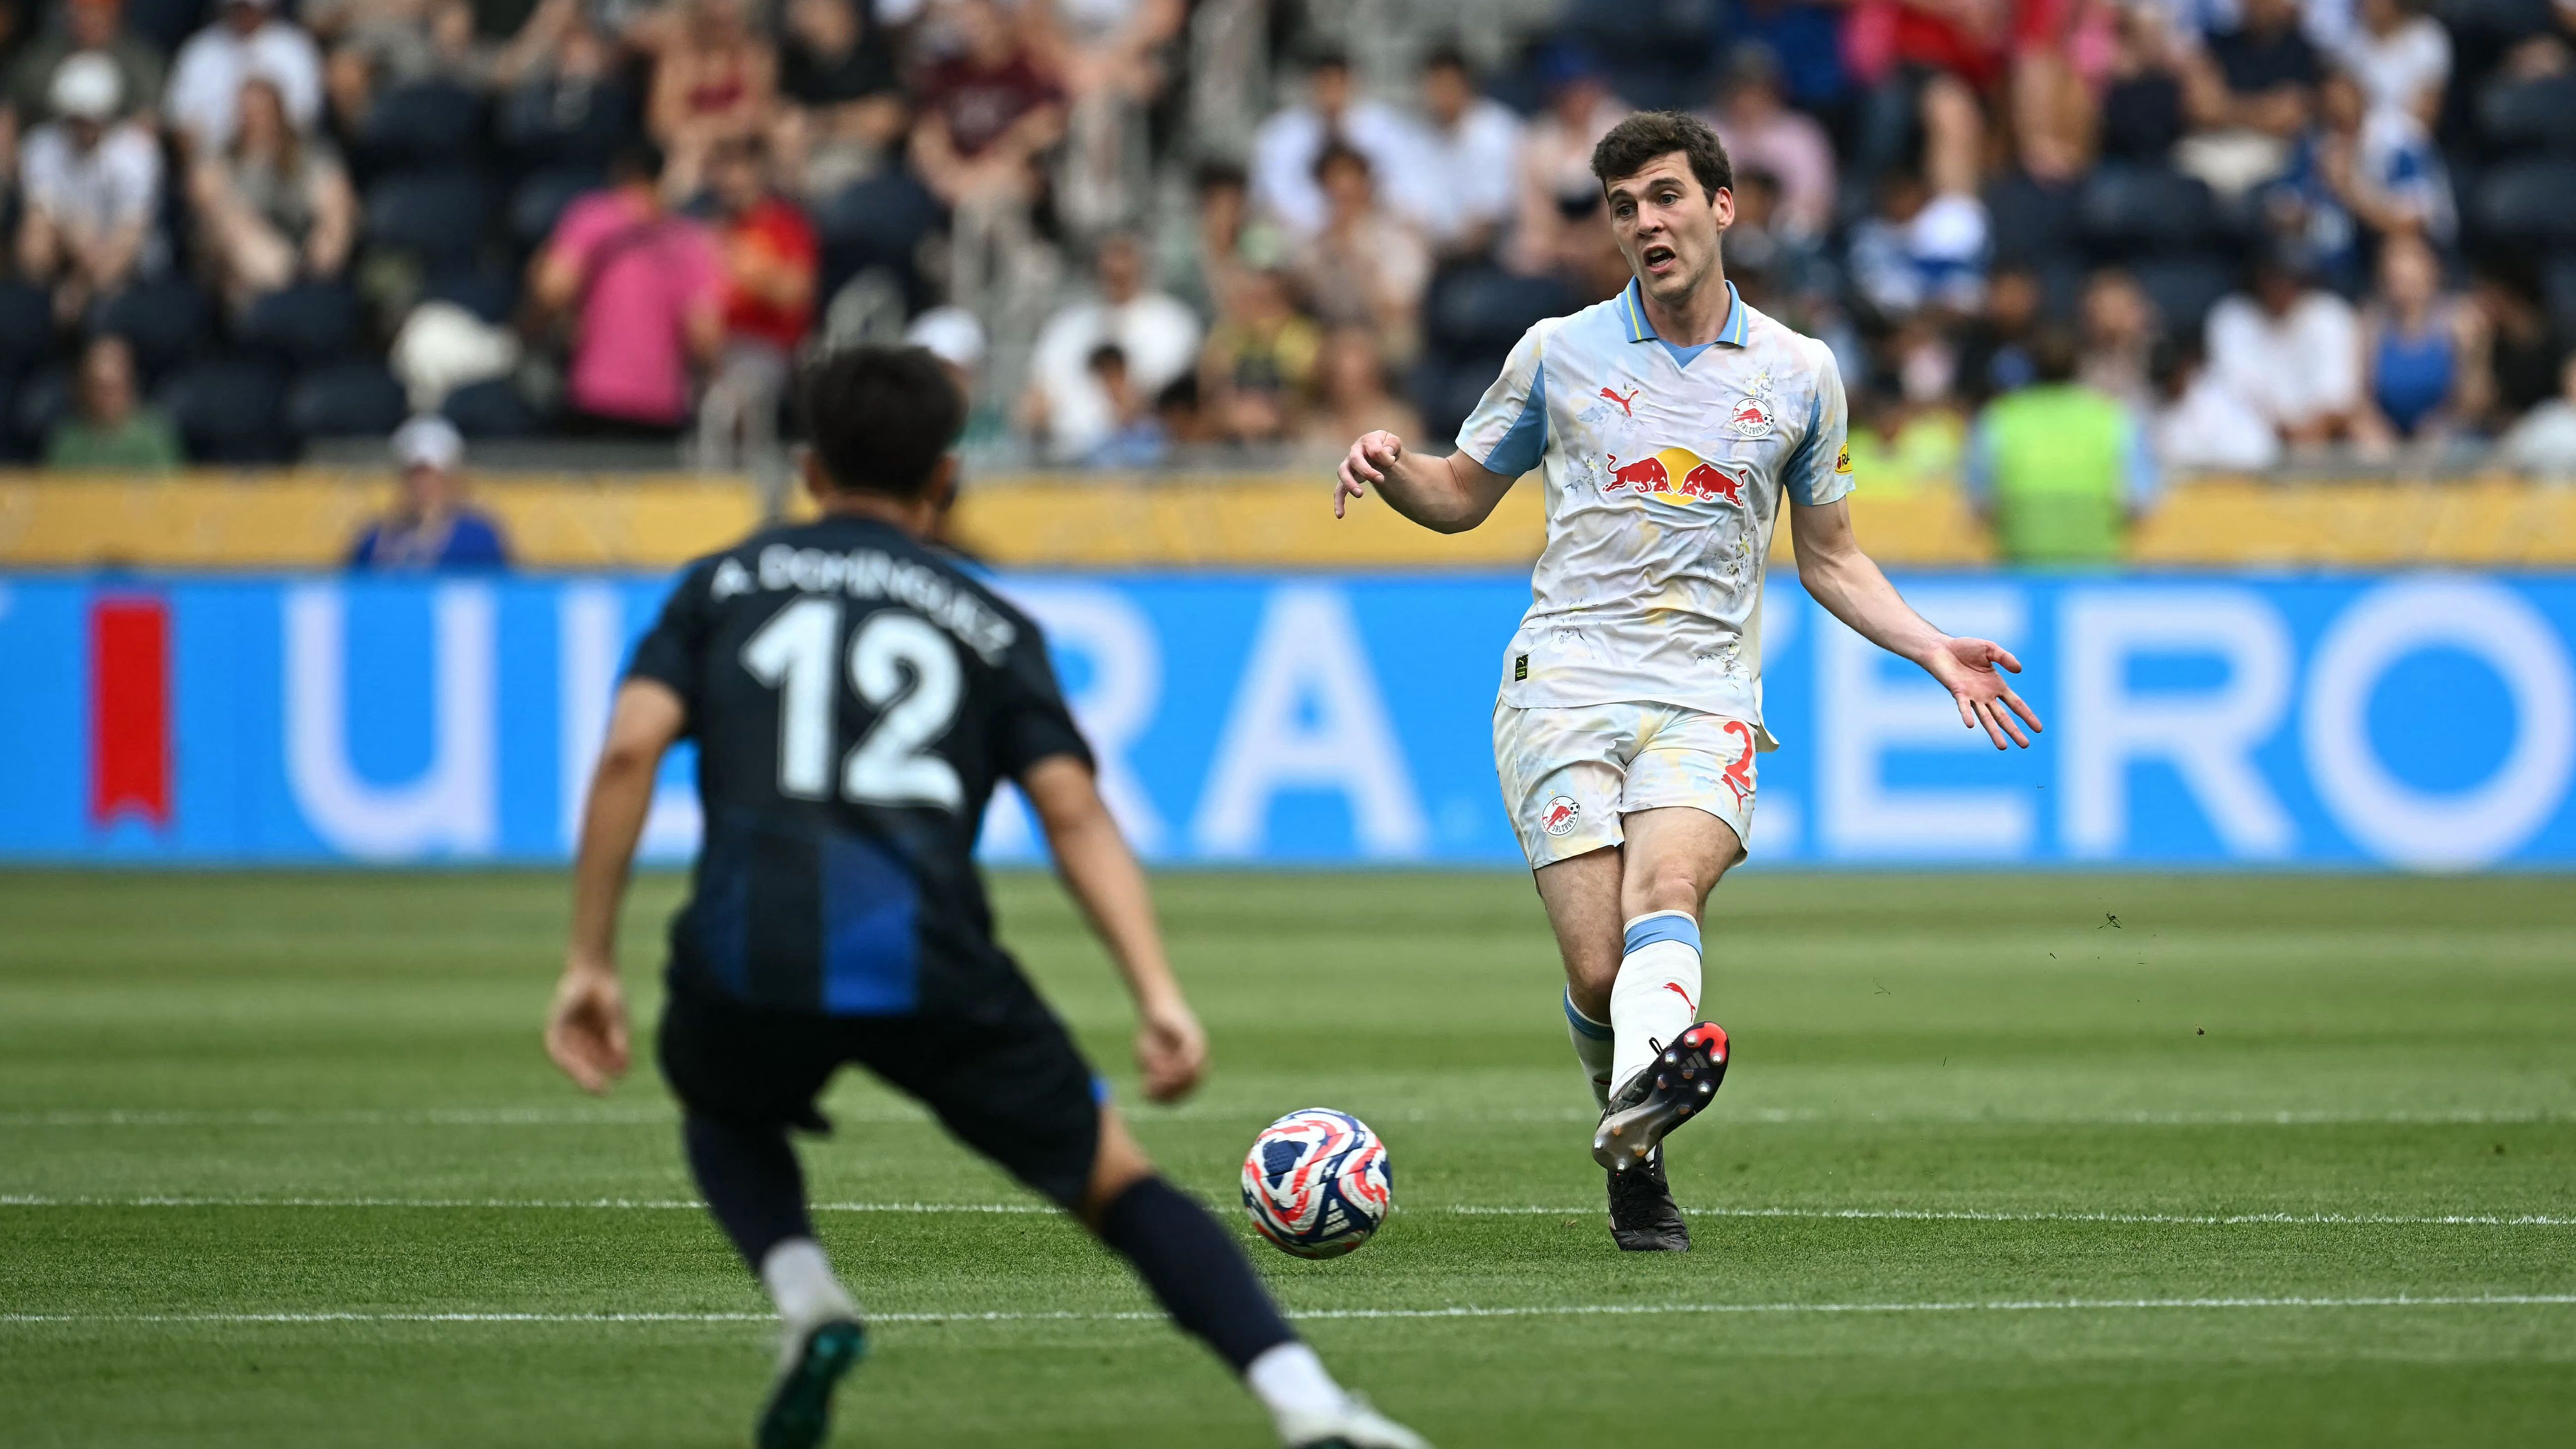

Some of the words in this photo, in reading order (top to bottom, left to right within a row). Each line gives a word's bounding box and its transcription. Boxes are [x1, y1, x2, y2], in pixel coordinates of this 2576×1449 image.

[1739, 422, 1765, 435] SALZBURG
[282, 573, 1433, 867] ULRA
[1753, 568, 2574, 876] ERO
[738, 593, 968, 814] 12
[1723, 721, 1752, 789] 2
[1551, 799, 1560, 808] FC
[1552, 816, 1576, 833] SALZBURG
